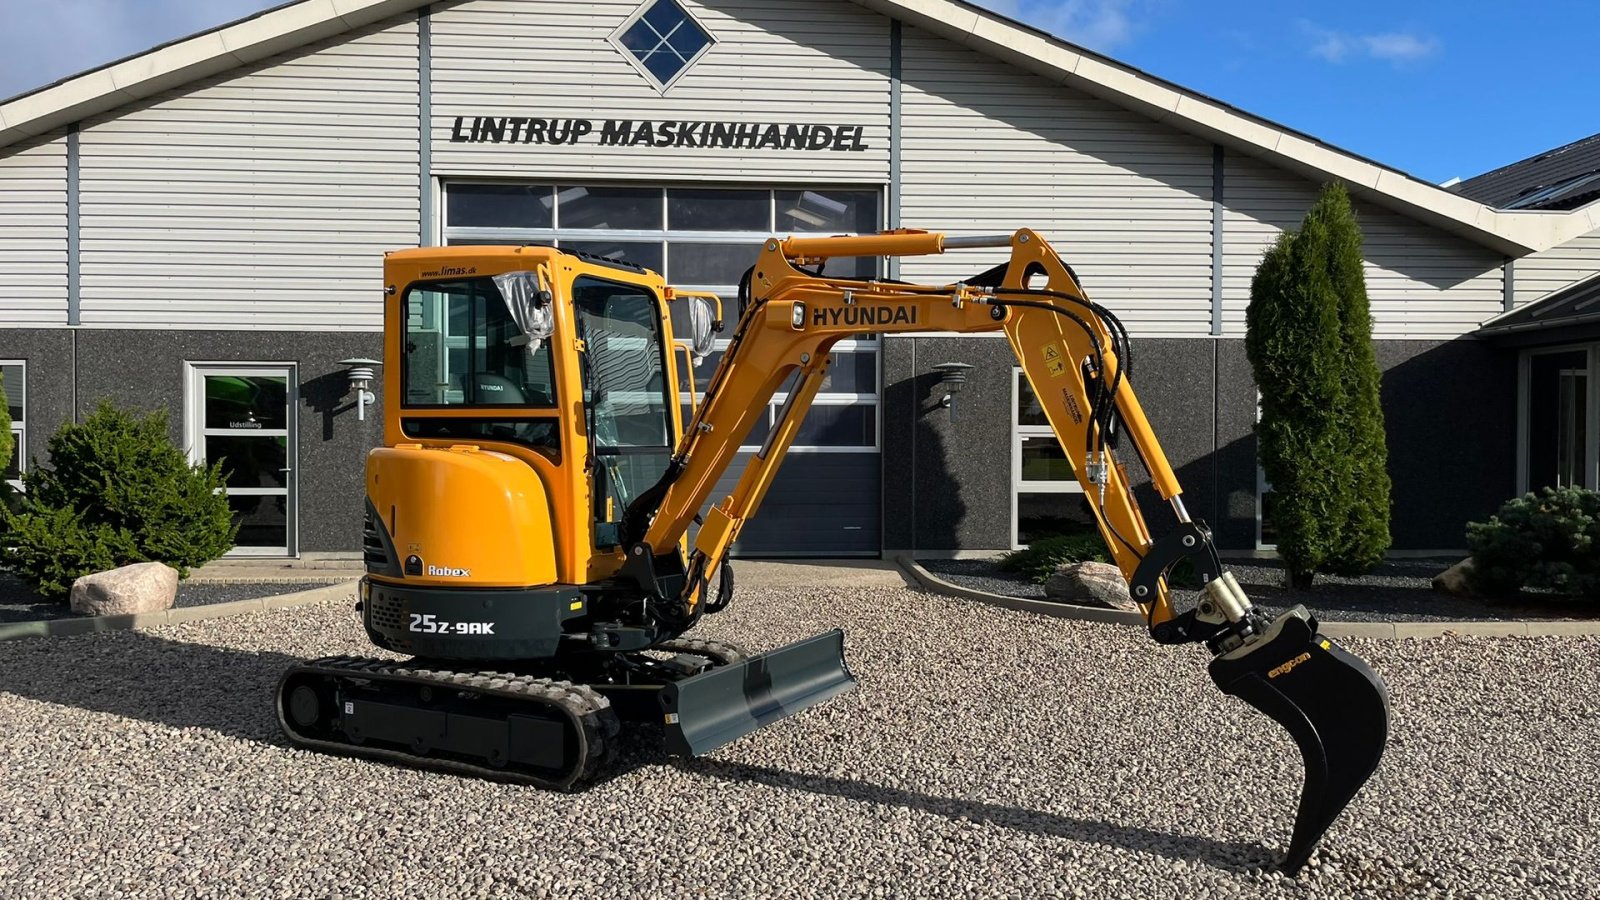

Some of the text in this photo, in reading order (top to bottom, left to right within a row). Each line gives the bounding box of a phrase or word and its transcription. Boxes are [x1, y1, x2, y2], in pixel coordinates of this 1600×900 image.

[449, 116, 869, 151] LINTRUP MASKINHANDEL
[421, 265, 477, 277] www.limas.dk
[813, 305, 917, 326] HYUNDAI
[229, 421, 262, 429] Udstilling
[428, 565, 471, 577] Robex
[1267, 652, 1312, 679] engcon
